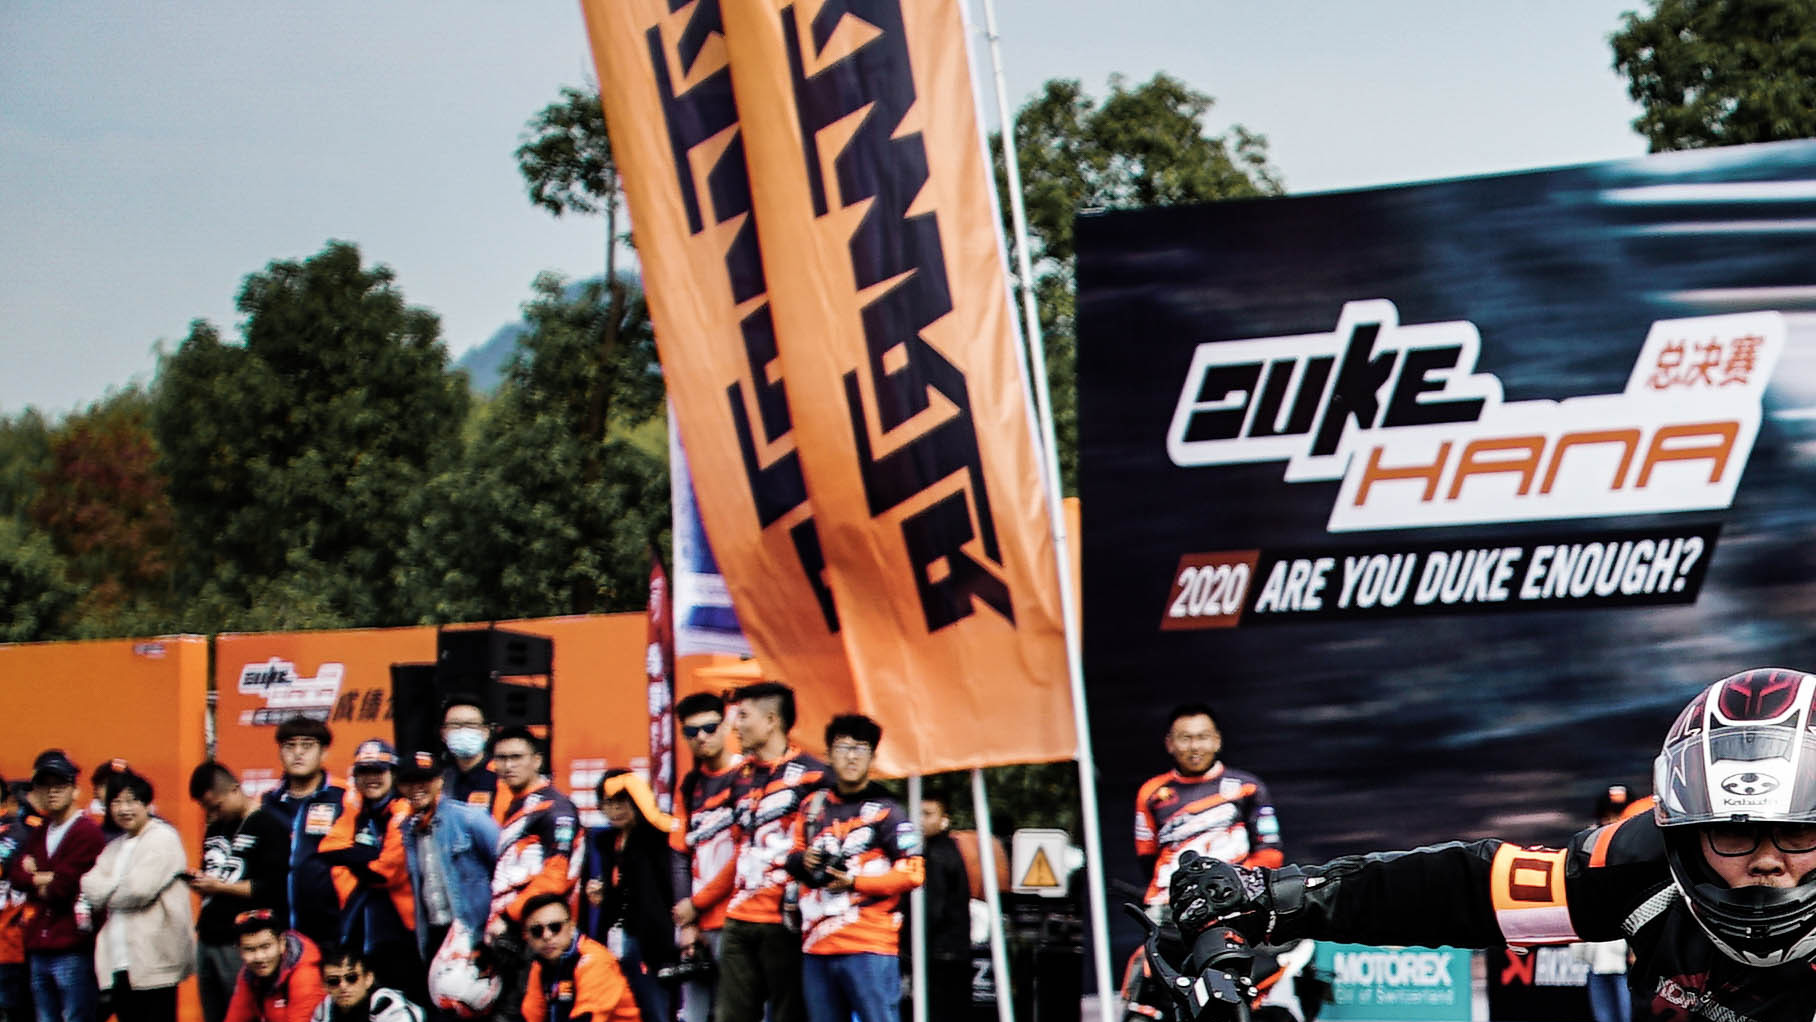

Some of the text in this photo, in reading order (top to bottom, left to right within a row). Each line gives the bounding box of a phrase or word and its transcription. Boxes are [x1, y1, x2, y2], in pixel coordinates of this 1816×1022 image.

[1645, 333, 1766, 392] 总决赛
[1352, 420, 1741, 508] HANA
[1168, 535, 1705, 618] 2020 ARE YOU DUKE ENOUGH?
[1333, 951, 1455, 986] MOTOREX
